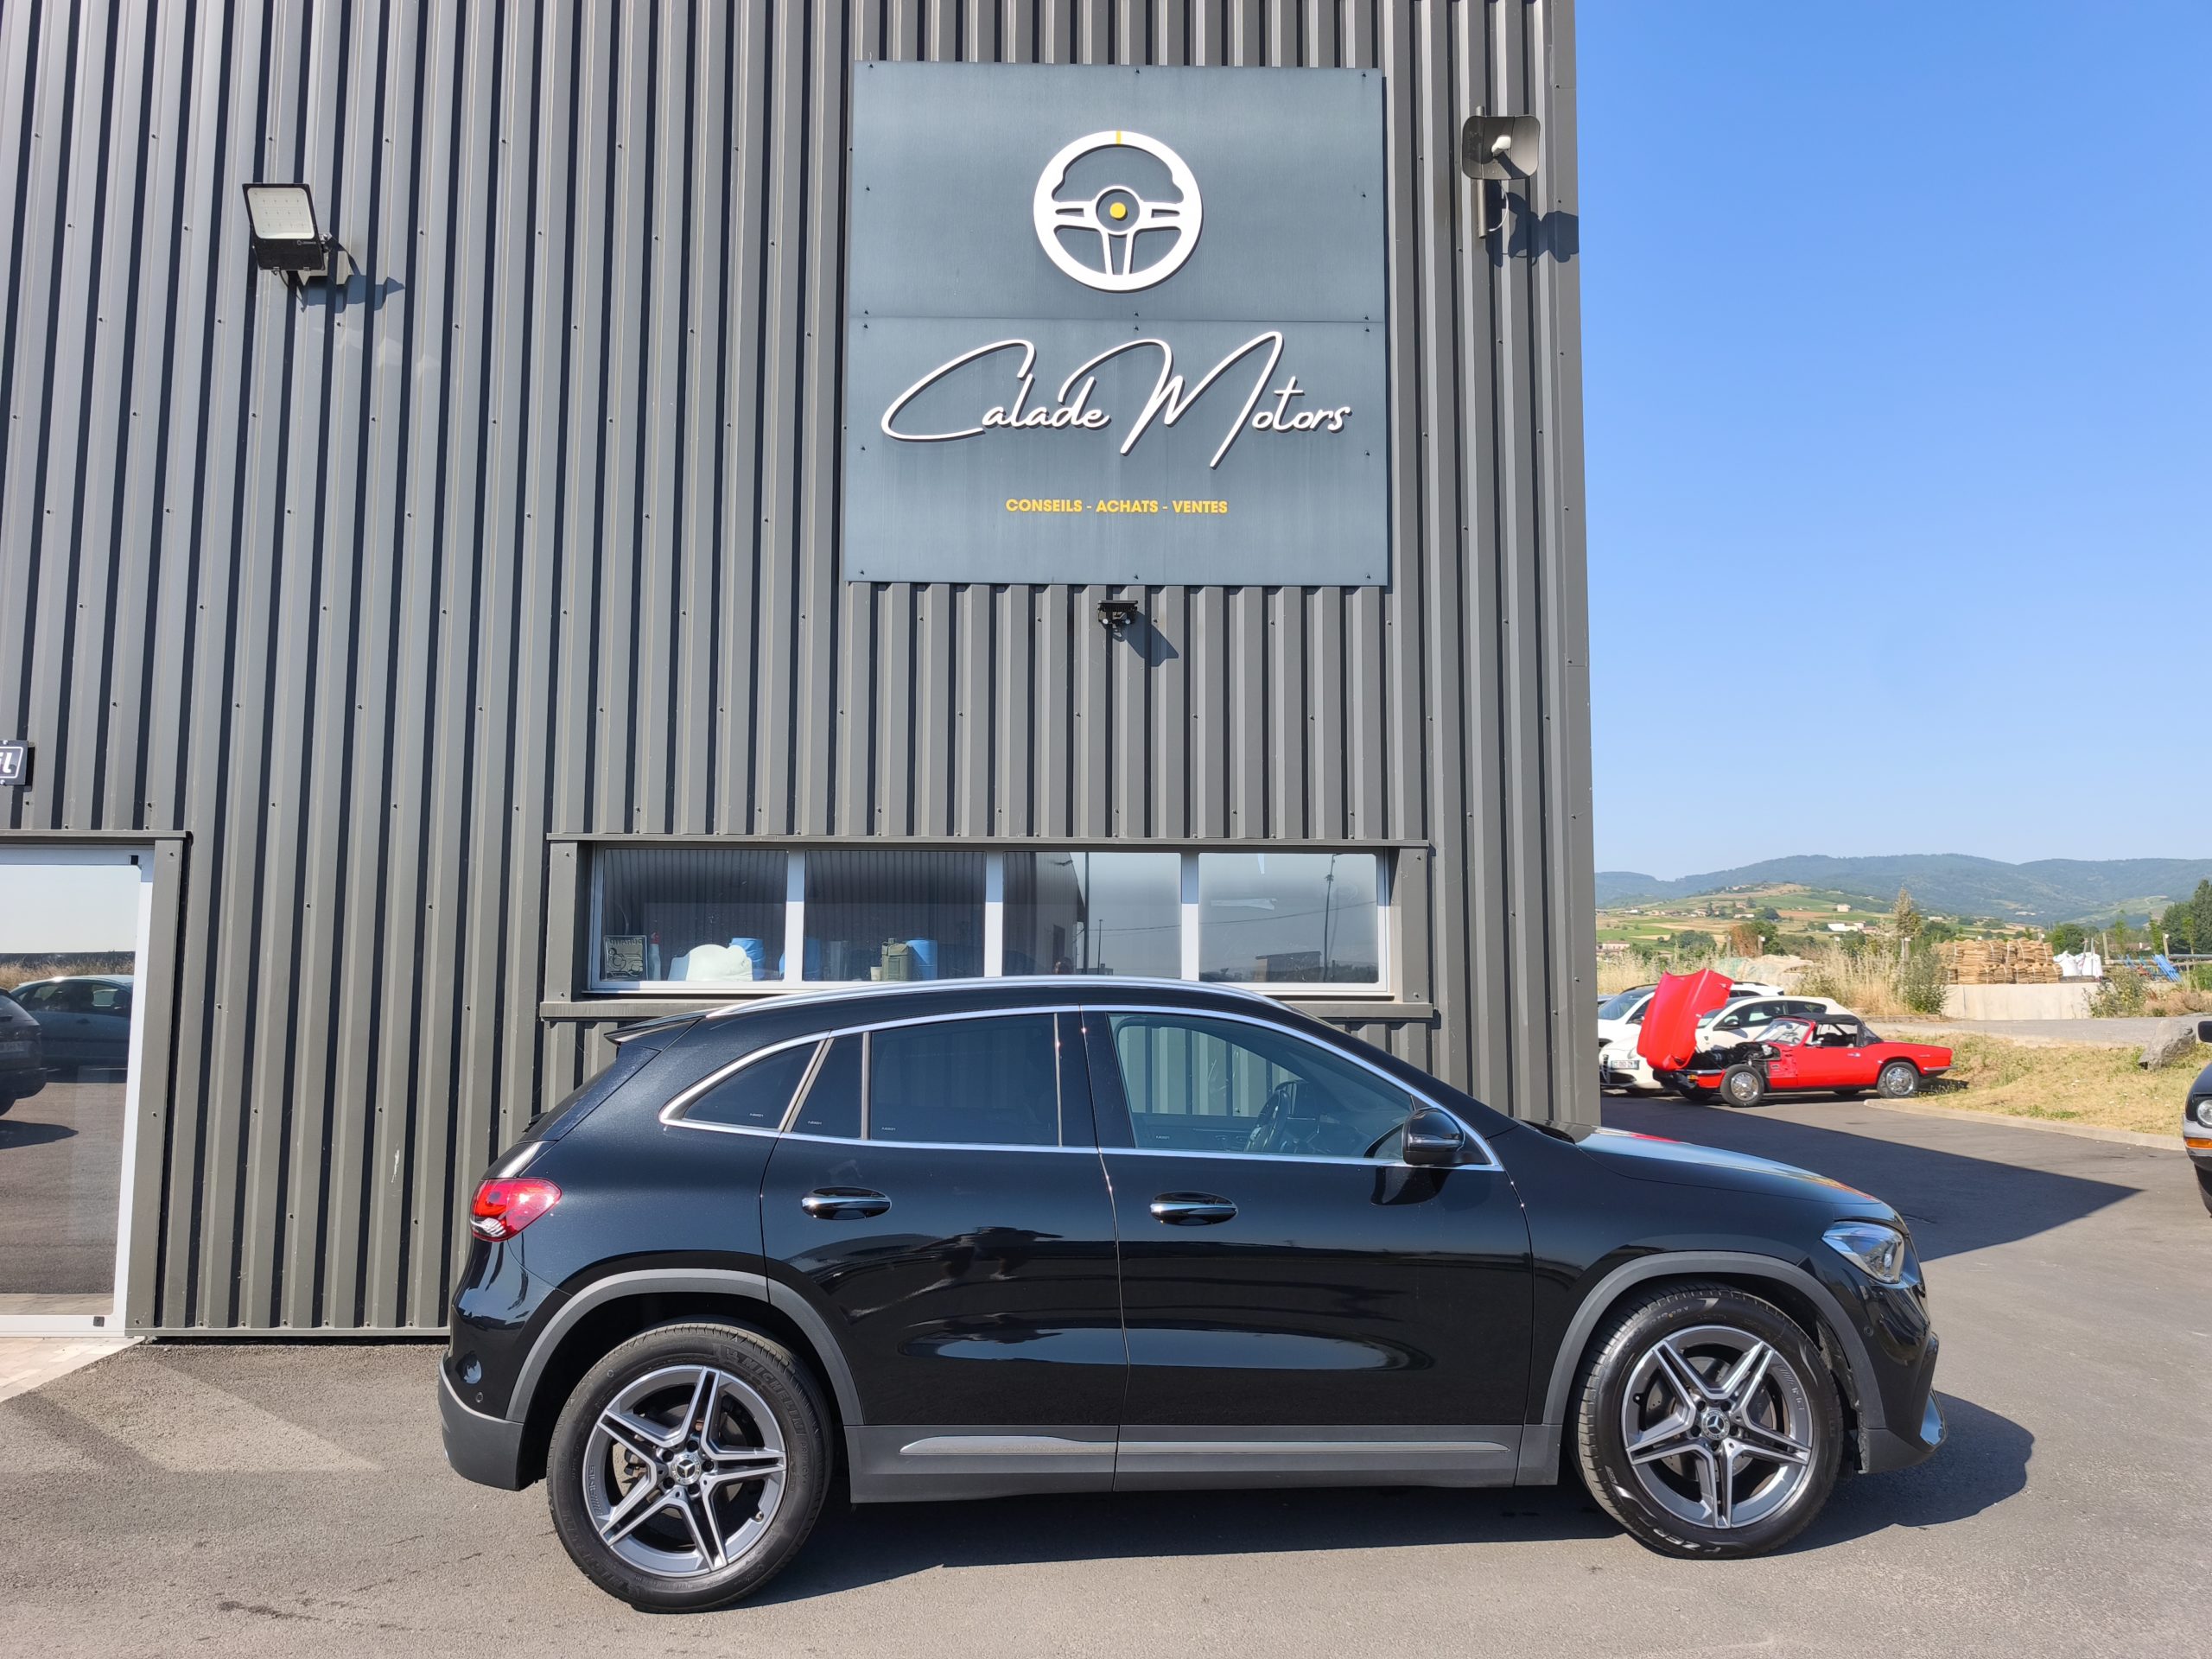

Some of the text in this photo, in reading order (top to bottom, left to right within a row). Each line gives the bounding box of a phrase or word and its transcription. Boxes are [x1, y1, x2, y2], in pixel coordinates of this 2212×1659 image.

[881, 330, 1351, 469] Calade Motors
[1005, 498, 1084, 513] CONSEILS
[1096, 499, 1160, 514] ACHATS
[1172, 499, 1229, 514] VENTES
[741, 1356, 807, 1435] MICHELIN
